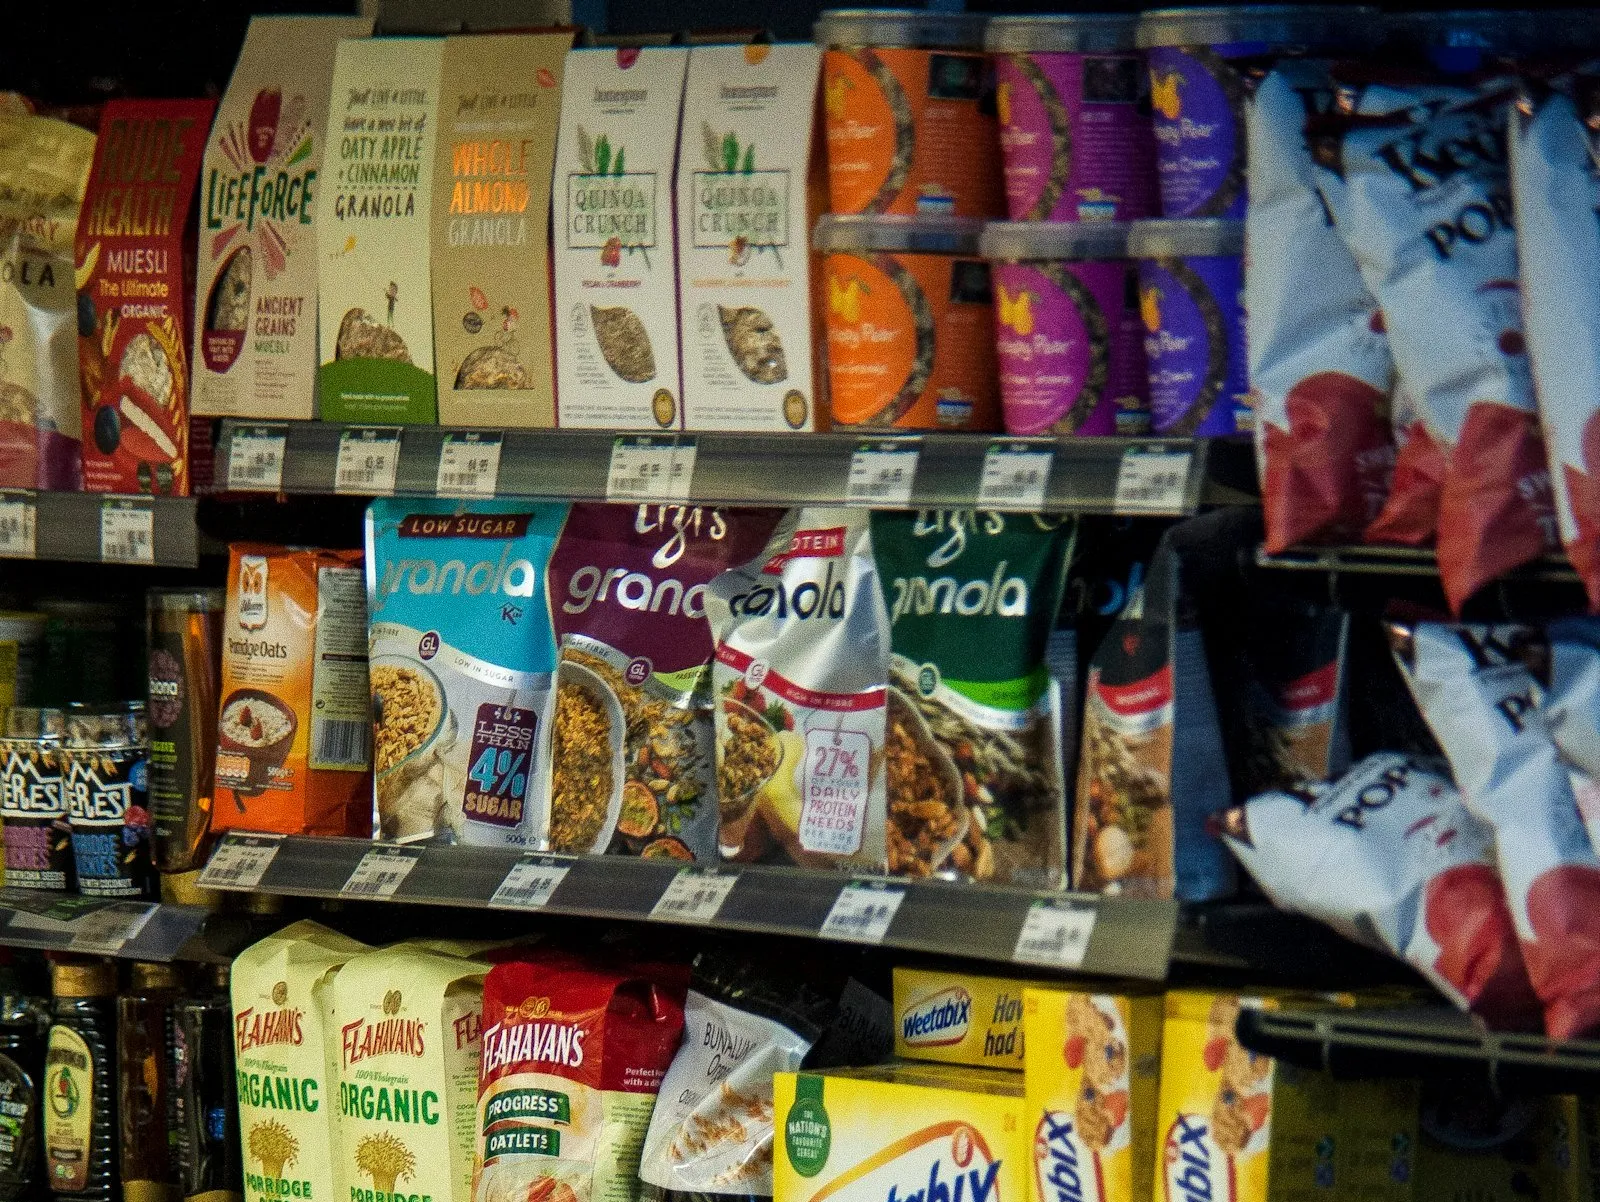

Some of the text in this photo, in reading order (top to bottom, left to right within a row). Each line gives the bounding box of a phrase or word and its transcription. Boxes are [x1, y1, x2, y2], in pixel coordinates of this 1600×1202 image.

[341, 135, 424, 160] OATY APPLE
[452, 139, 532, 176] WHOLE
[347, 163, 420, 184] CINNAMON
[335, 193, 415, 220] GRANOLA
[450, 181, 532, 215] ALMOND
[575, 188, 645, 211] QUINOA
[449, 218, 530, 247] GRANOLA
[573, 214, 647, 234] CRUNCH
[700, 212, 778, 232] CRUNCH
[106, 250, 168, 274] MUESLI
[100, 278, 169, 297] The Ultimate
[120, 304, 168, 318] ORGANIC
[256, 298, 303, 315] ANCIENT
[255, 318, 296, 337] GRAINS
[411, 519, 517, 534] LOW SUGAR
[259, 642, 287, 659] Oats
[421, 637, 437, 651] GL
[476, 733, 530, 750] THAN
[477, 720, 533, 741] LESS
[469, 746, 526, 798] 4%
[814, 746, 859, 779] 27%
[811, 786, 860, 800] DAILY
[465, 791, 522, 820] SUGAR
[809, 799, 857, 818] PROTEIN
[807, 816, 854, 832] NEEDS
[903, 998, 972, 1038] Weetabix
[341, 1017, 425, 1072] FLAHAVAN'S
[482, 1021, 585, 1082] FLAHAVAN'S
[983, 1028, 1018, 1057] had
[623, 1077, 644, 1087] with
[625, 1067, 654, 1077] Perfect
[236, 1070, 320, 1113] ORGANIC
[340, 1081, 440, 1126] ORGANIC
[488, 1094, 559, 1120] PROGRESS
[788, 1121, 828, 1140] NATION'S
[246, 1172, 313, 1200] PORRIDGE
